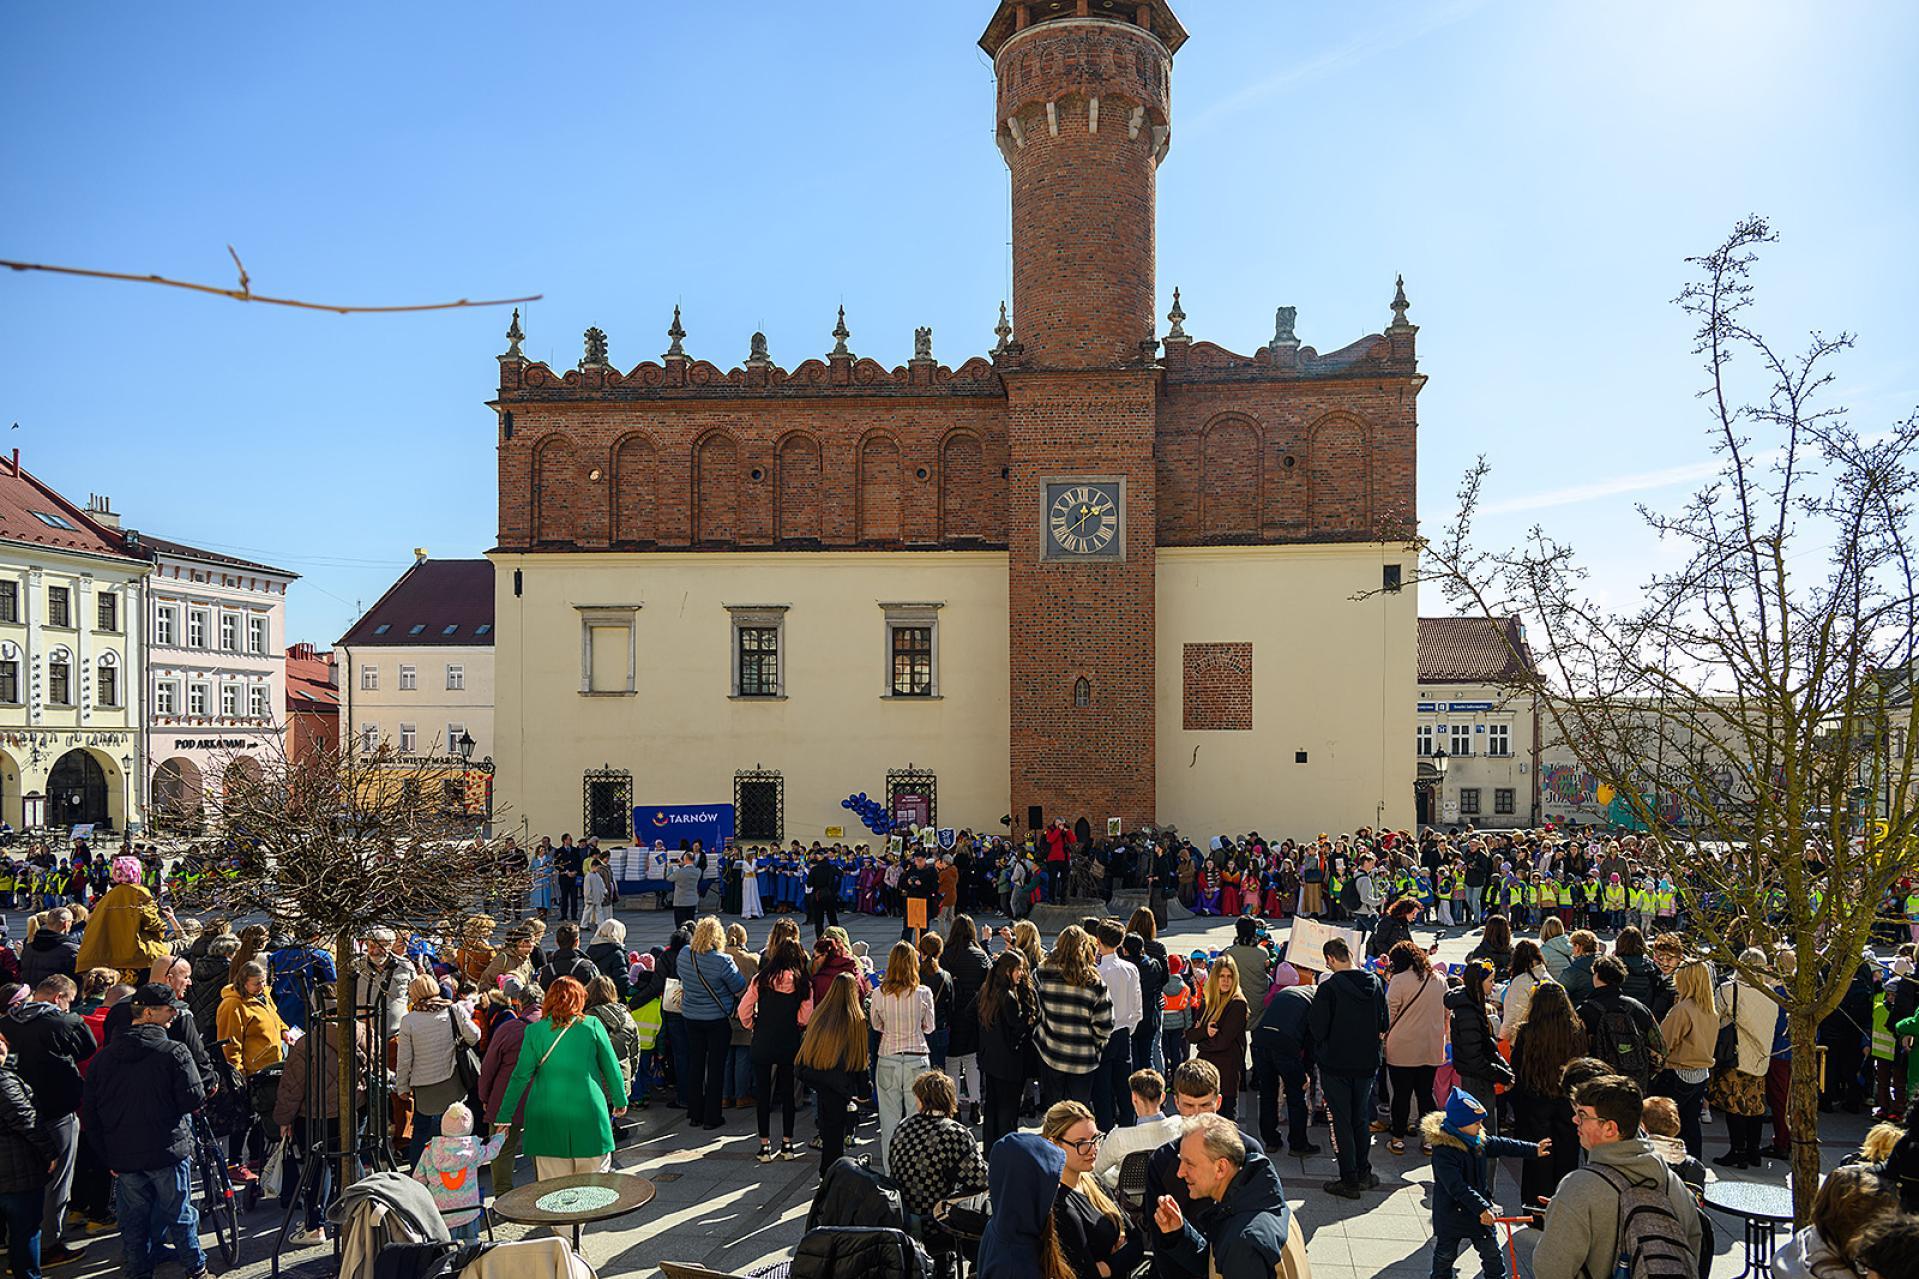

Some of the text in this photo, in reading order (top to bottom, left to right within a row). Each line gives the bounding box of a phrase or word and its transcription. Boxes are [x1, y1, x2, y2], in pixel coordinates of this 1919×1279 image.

[175, 739, 196, 749] POD
[196, 739, 246, 749] ARKADAMI
[669, 811, 718, 824] TARNÓW
